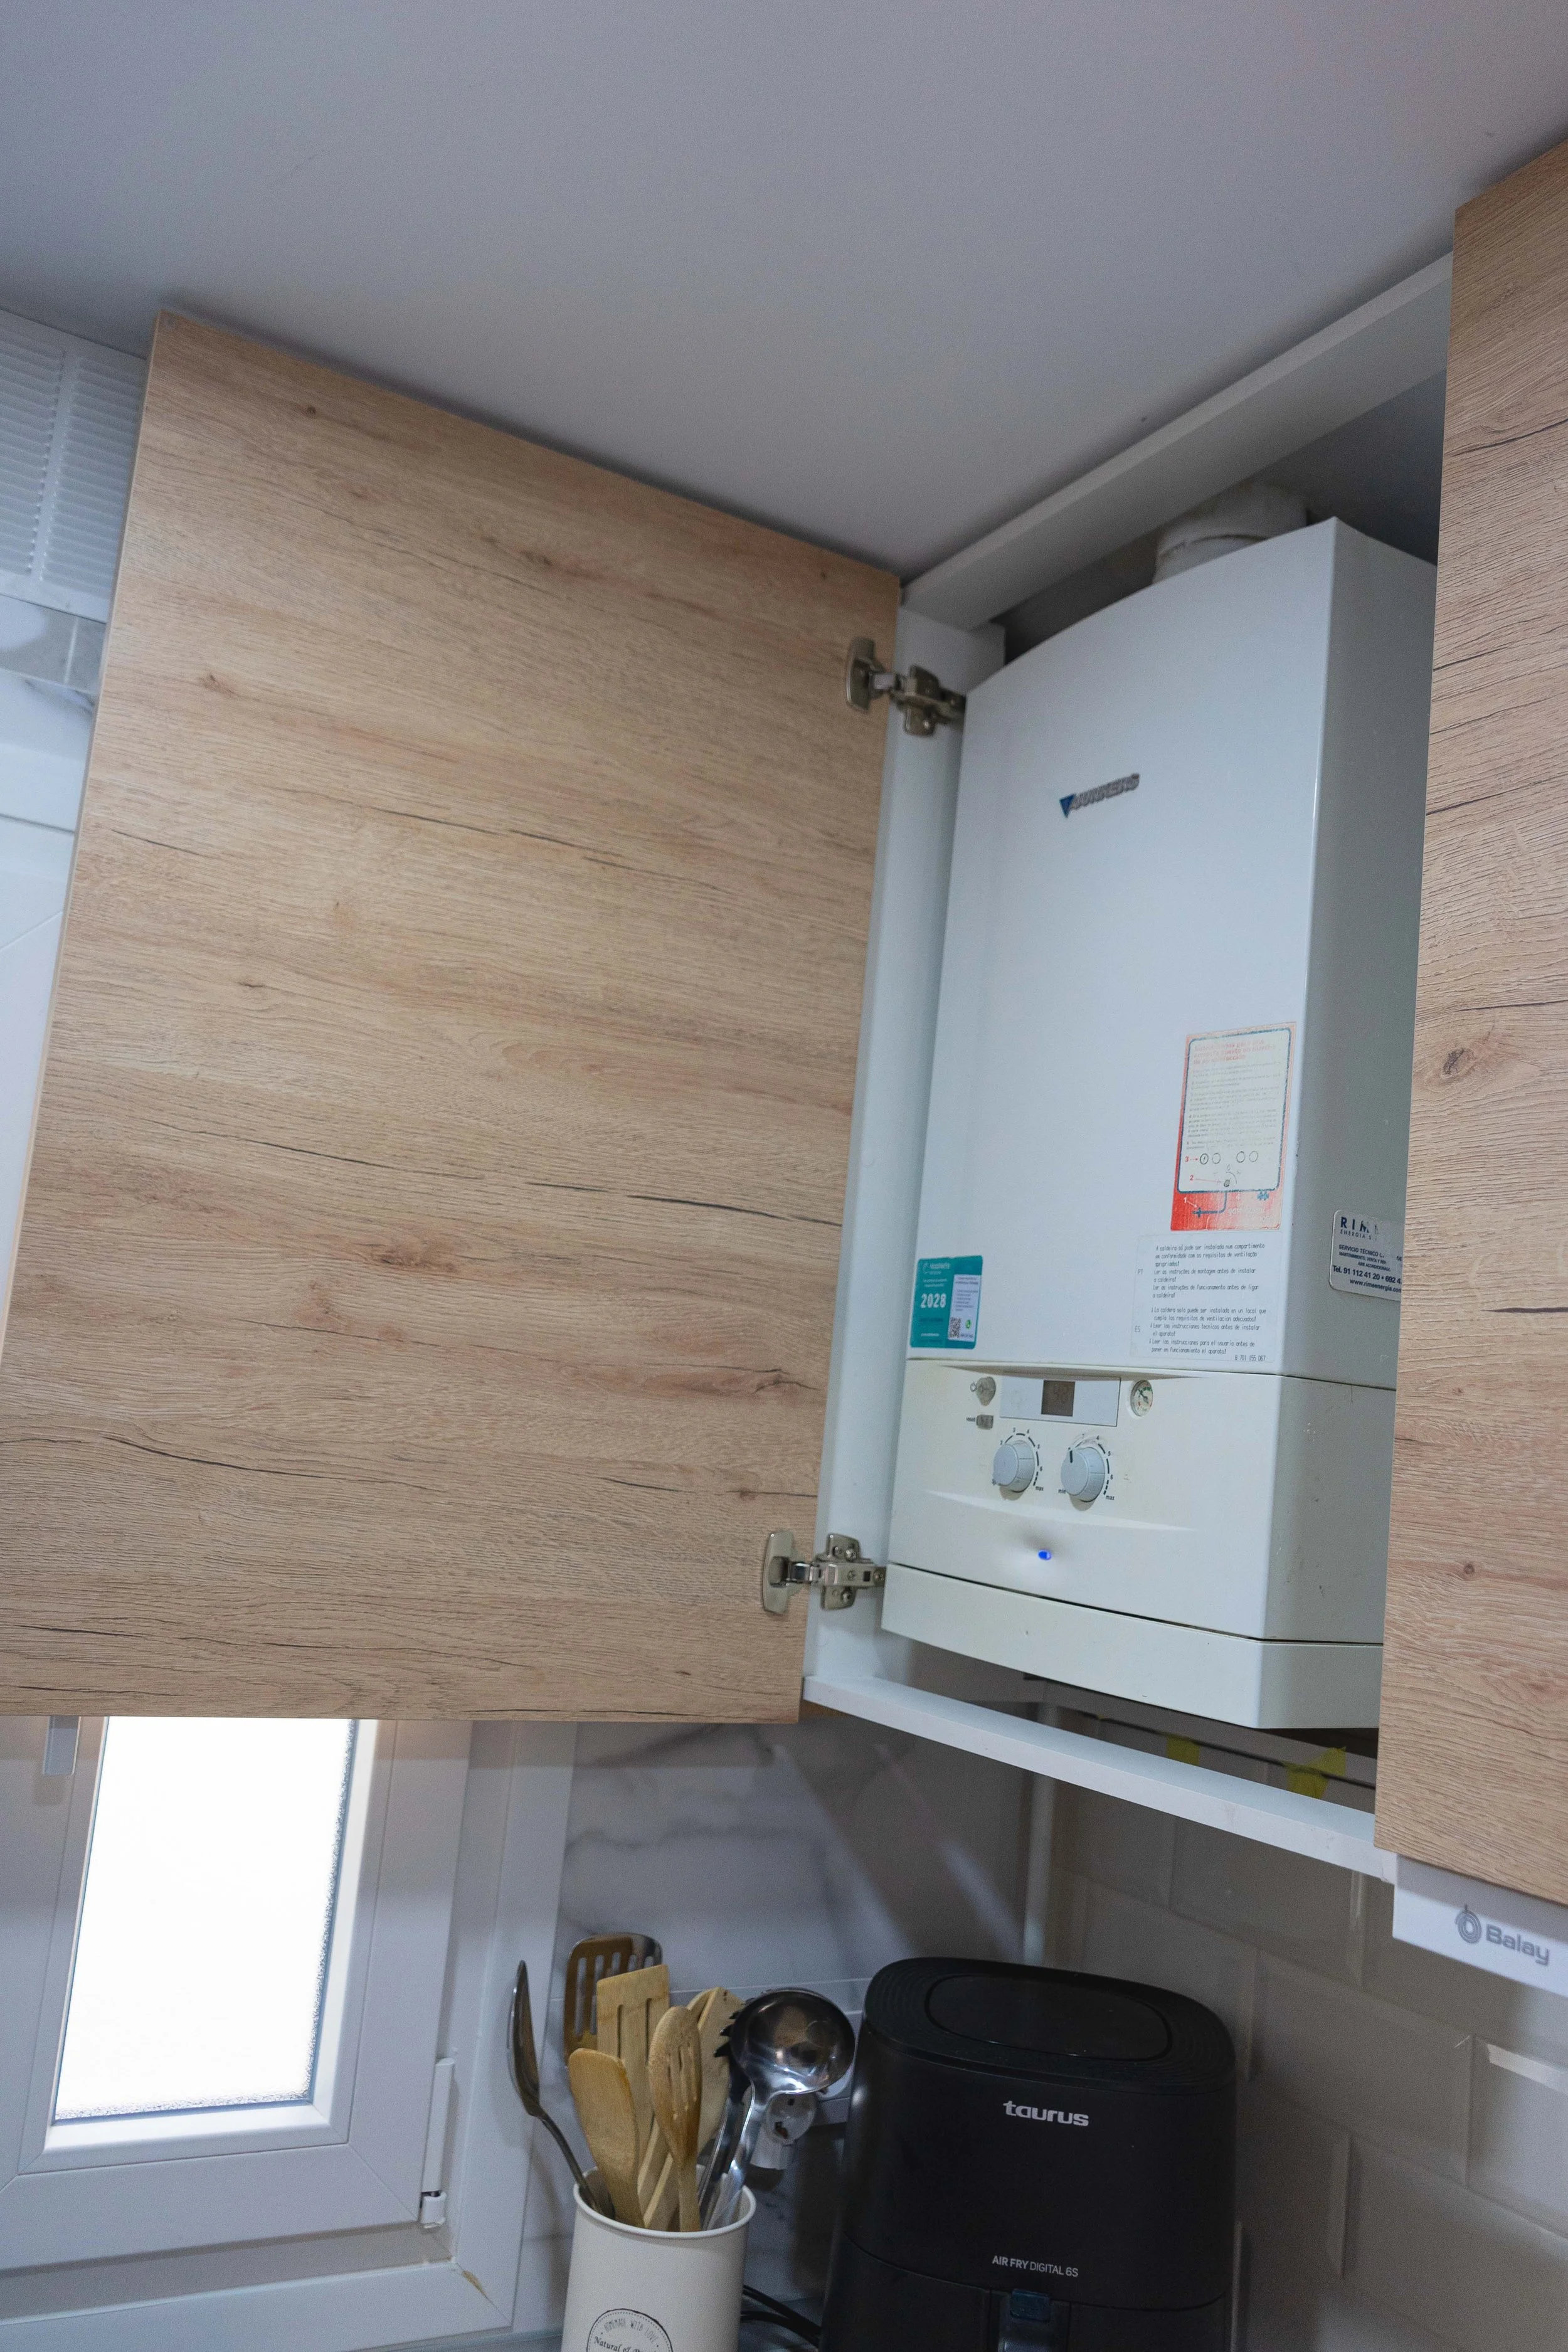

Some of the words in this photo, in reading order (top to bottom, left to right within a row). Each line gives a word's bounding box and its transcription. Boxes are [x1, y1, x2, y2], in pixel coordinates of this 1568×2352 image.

[1339, 1244, 1359, 1253] SERVICIO
[1343, 1267, 1350, 1275] 91
[1353, 1269, 1363, 1278] 112
[920, 1293, 947, 1309] 2028
[1485, 1922, 1550, 1967] Balay
[1002, 2100, 1090, 2127] taurus
[992, 2255, 1009, 2267] AIR
[1009, 2258, 1029, 2269] FRY
[1030, 2261, 1064, 2276] DIGITAL
[1065, 2266, 1079, 2278] 6S
[593, 2336, 623, 2352] Natural
